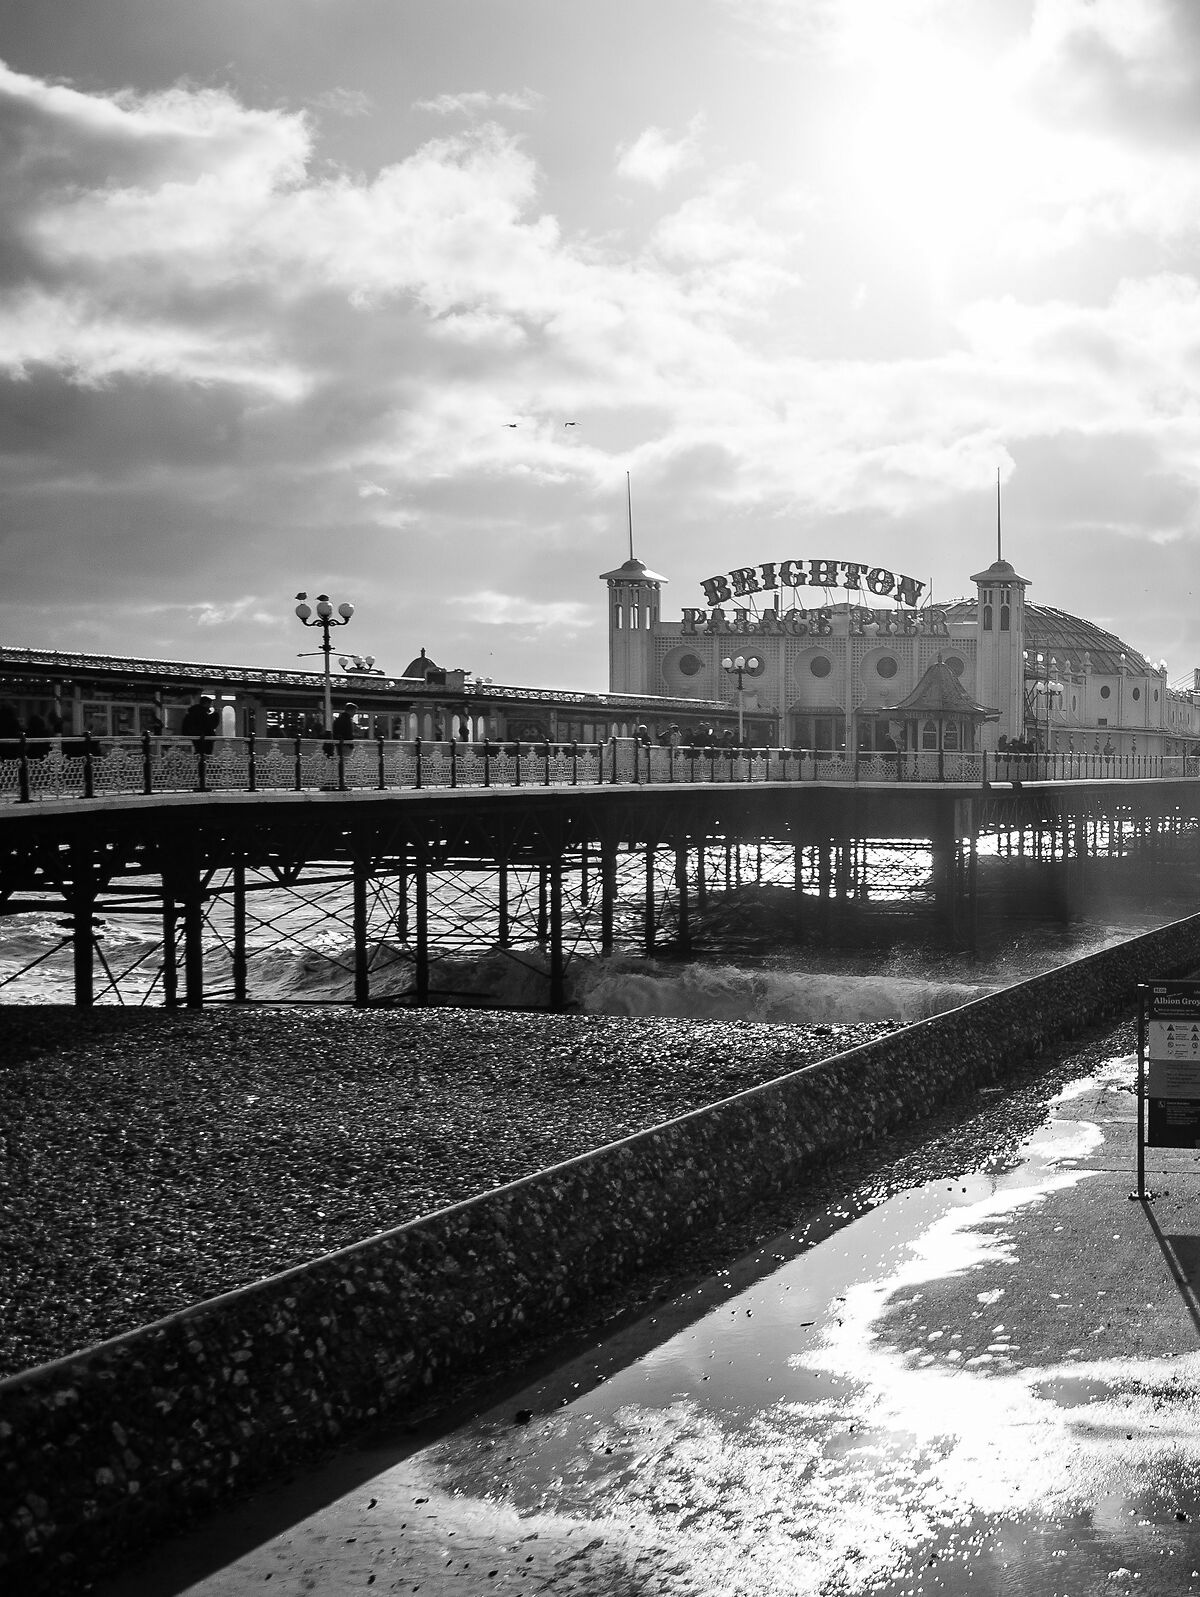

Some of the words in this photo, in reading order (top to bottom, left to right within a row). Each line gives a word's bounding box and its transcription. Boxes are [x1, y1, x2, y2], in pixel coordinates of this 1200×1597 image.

[700, 560, 926, 606] BRIGHTON
[681, 608, 832, 636] PALACE
[849, 608, 949, 637] PIER
